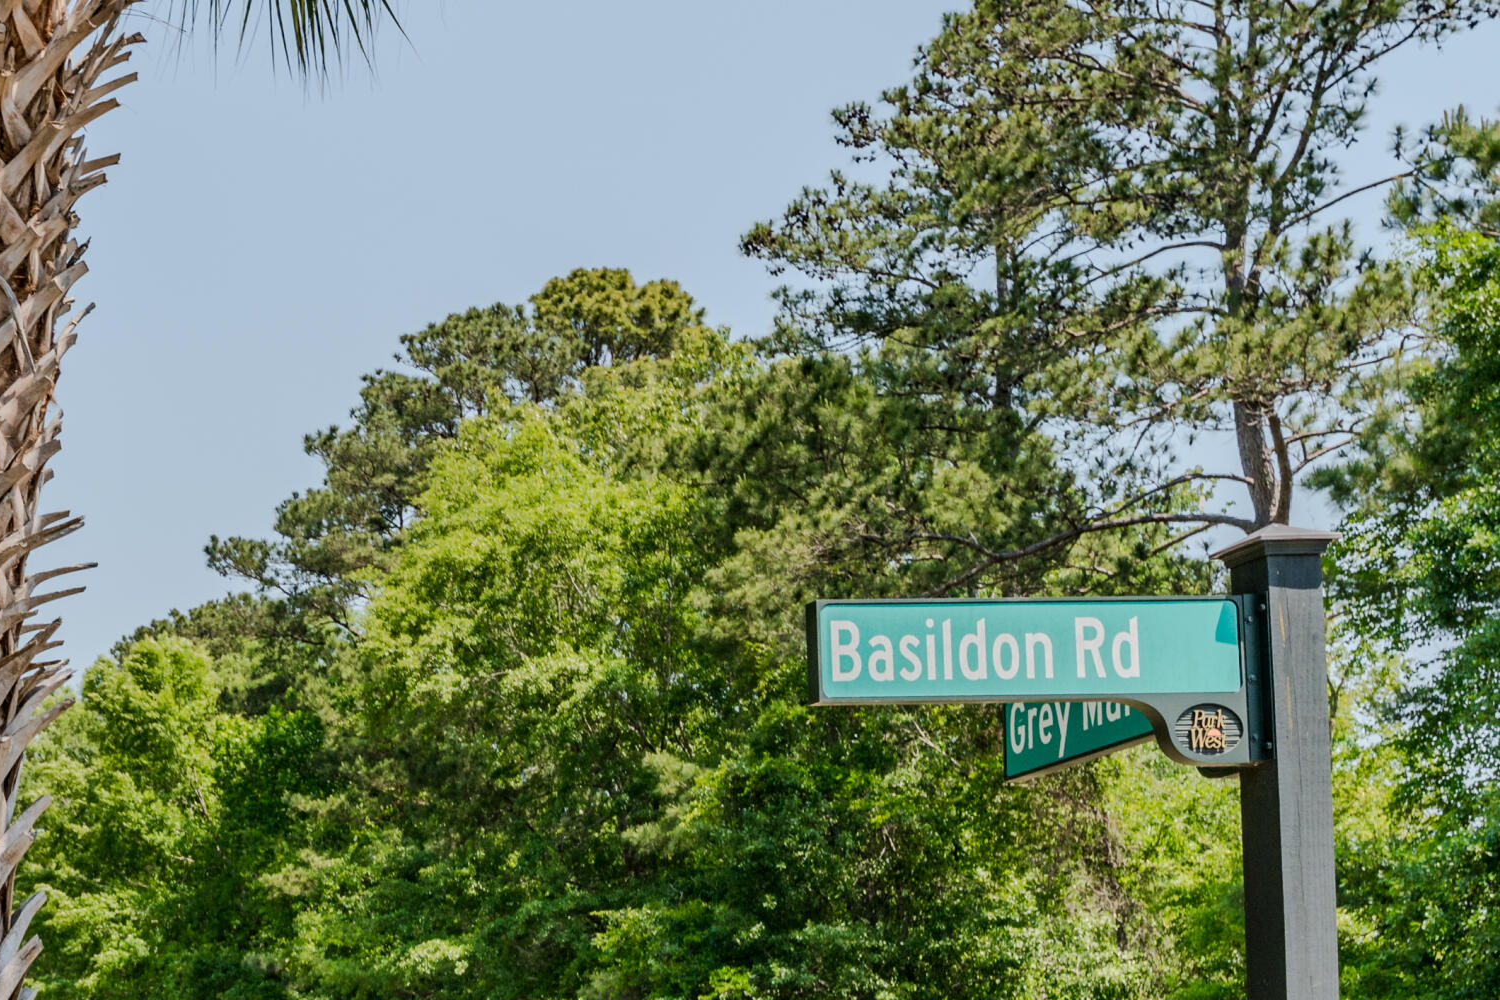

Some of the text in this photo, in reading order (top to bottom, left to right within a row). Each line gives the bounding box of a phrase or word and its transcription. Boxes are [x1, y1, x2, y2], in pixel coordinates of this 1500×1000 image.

[830, 615, 1141, 682] Basildon Rd
[1010, 701, 1070, 758] Grey
[1190, 727, 1227, 750] West
[1193, 708, 1227, 729] Park
